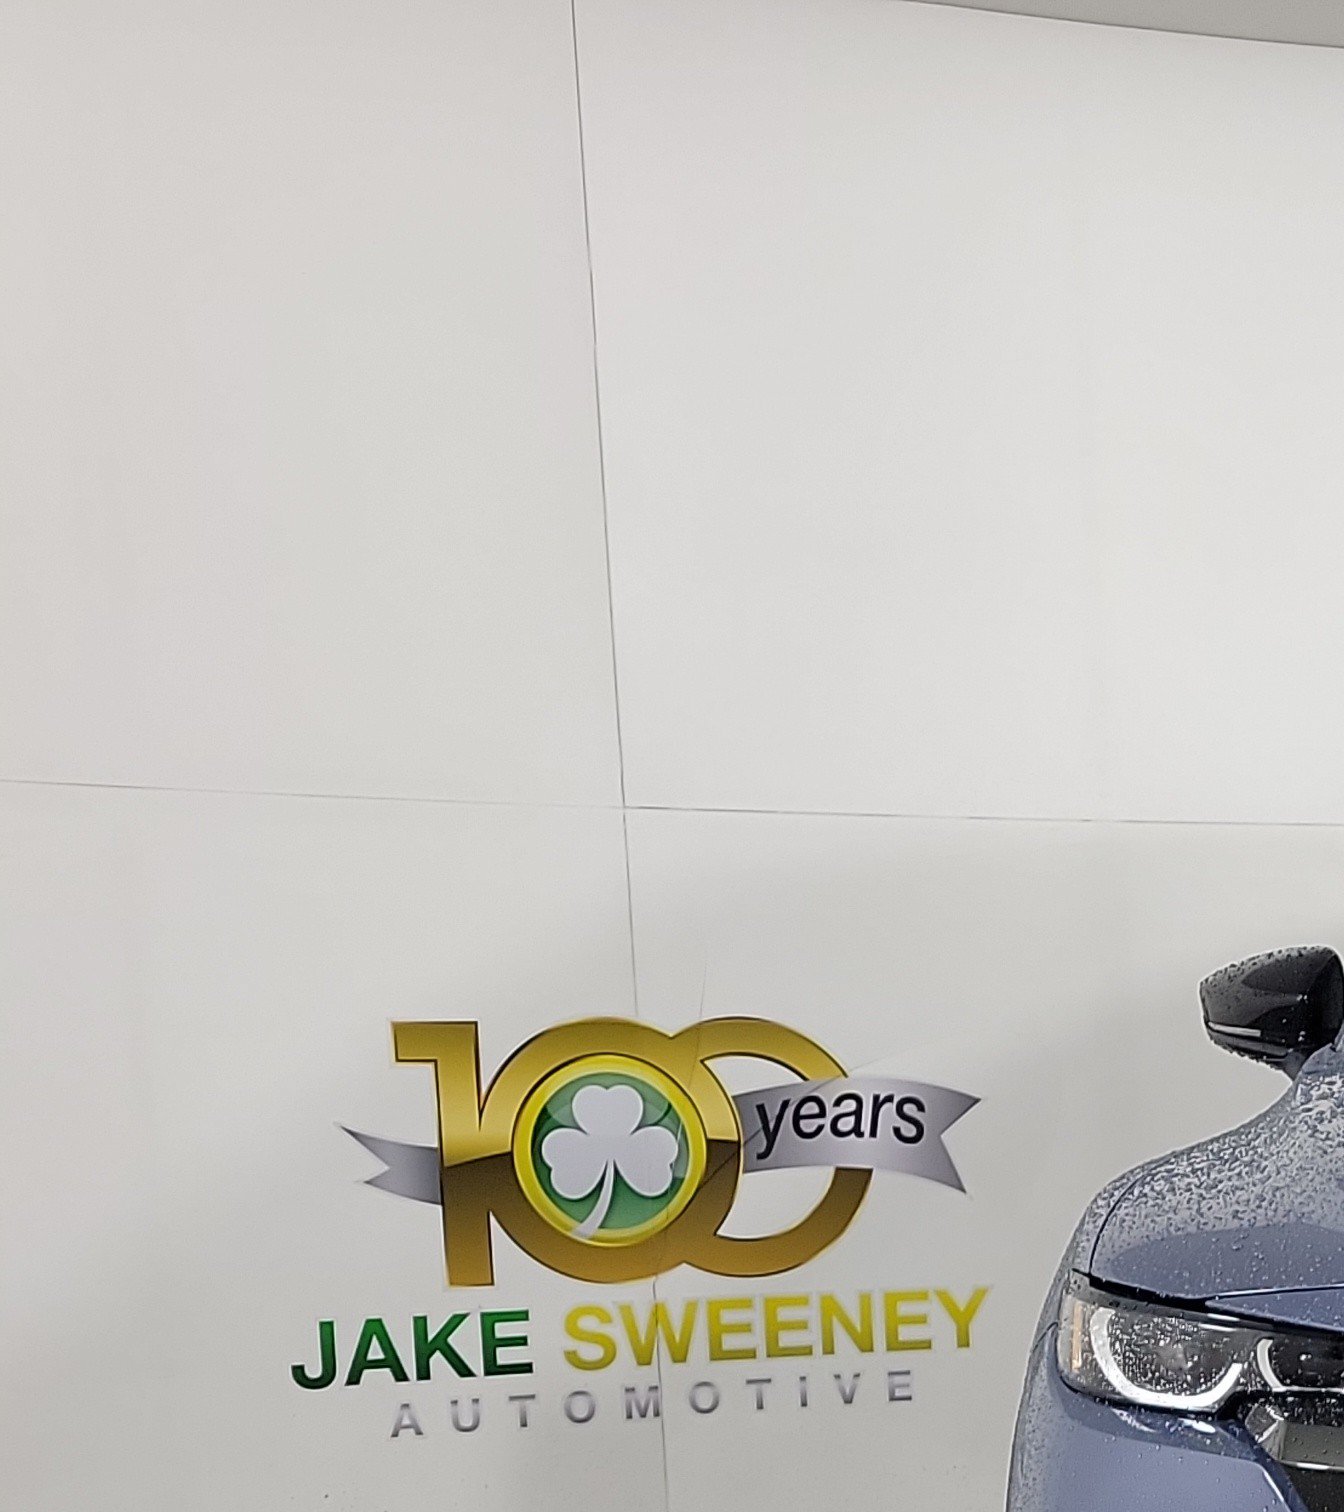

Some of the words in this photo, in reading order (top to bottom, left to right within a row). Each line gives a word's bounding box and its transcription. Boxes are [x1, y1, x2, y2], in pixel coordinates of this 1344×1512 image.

[755, 1091, 926, 1160] years
[290, 1308, 535, 1390] JAKE
[562, 1287, 990, 1372] SWEENEY
[390, 1370, 914, 1439] AUTOMOTIVE
